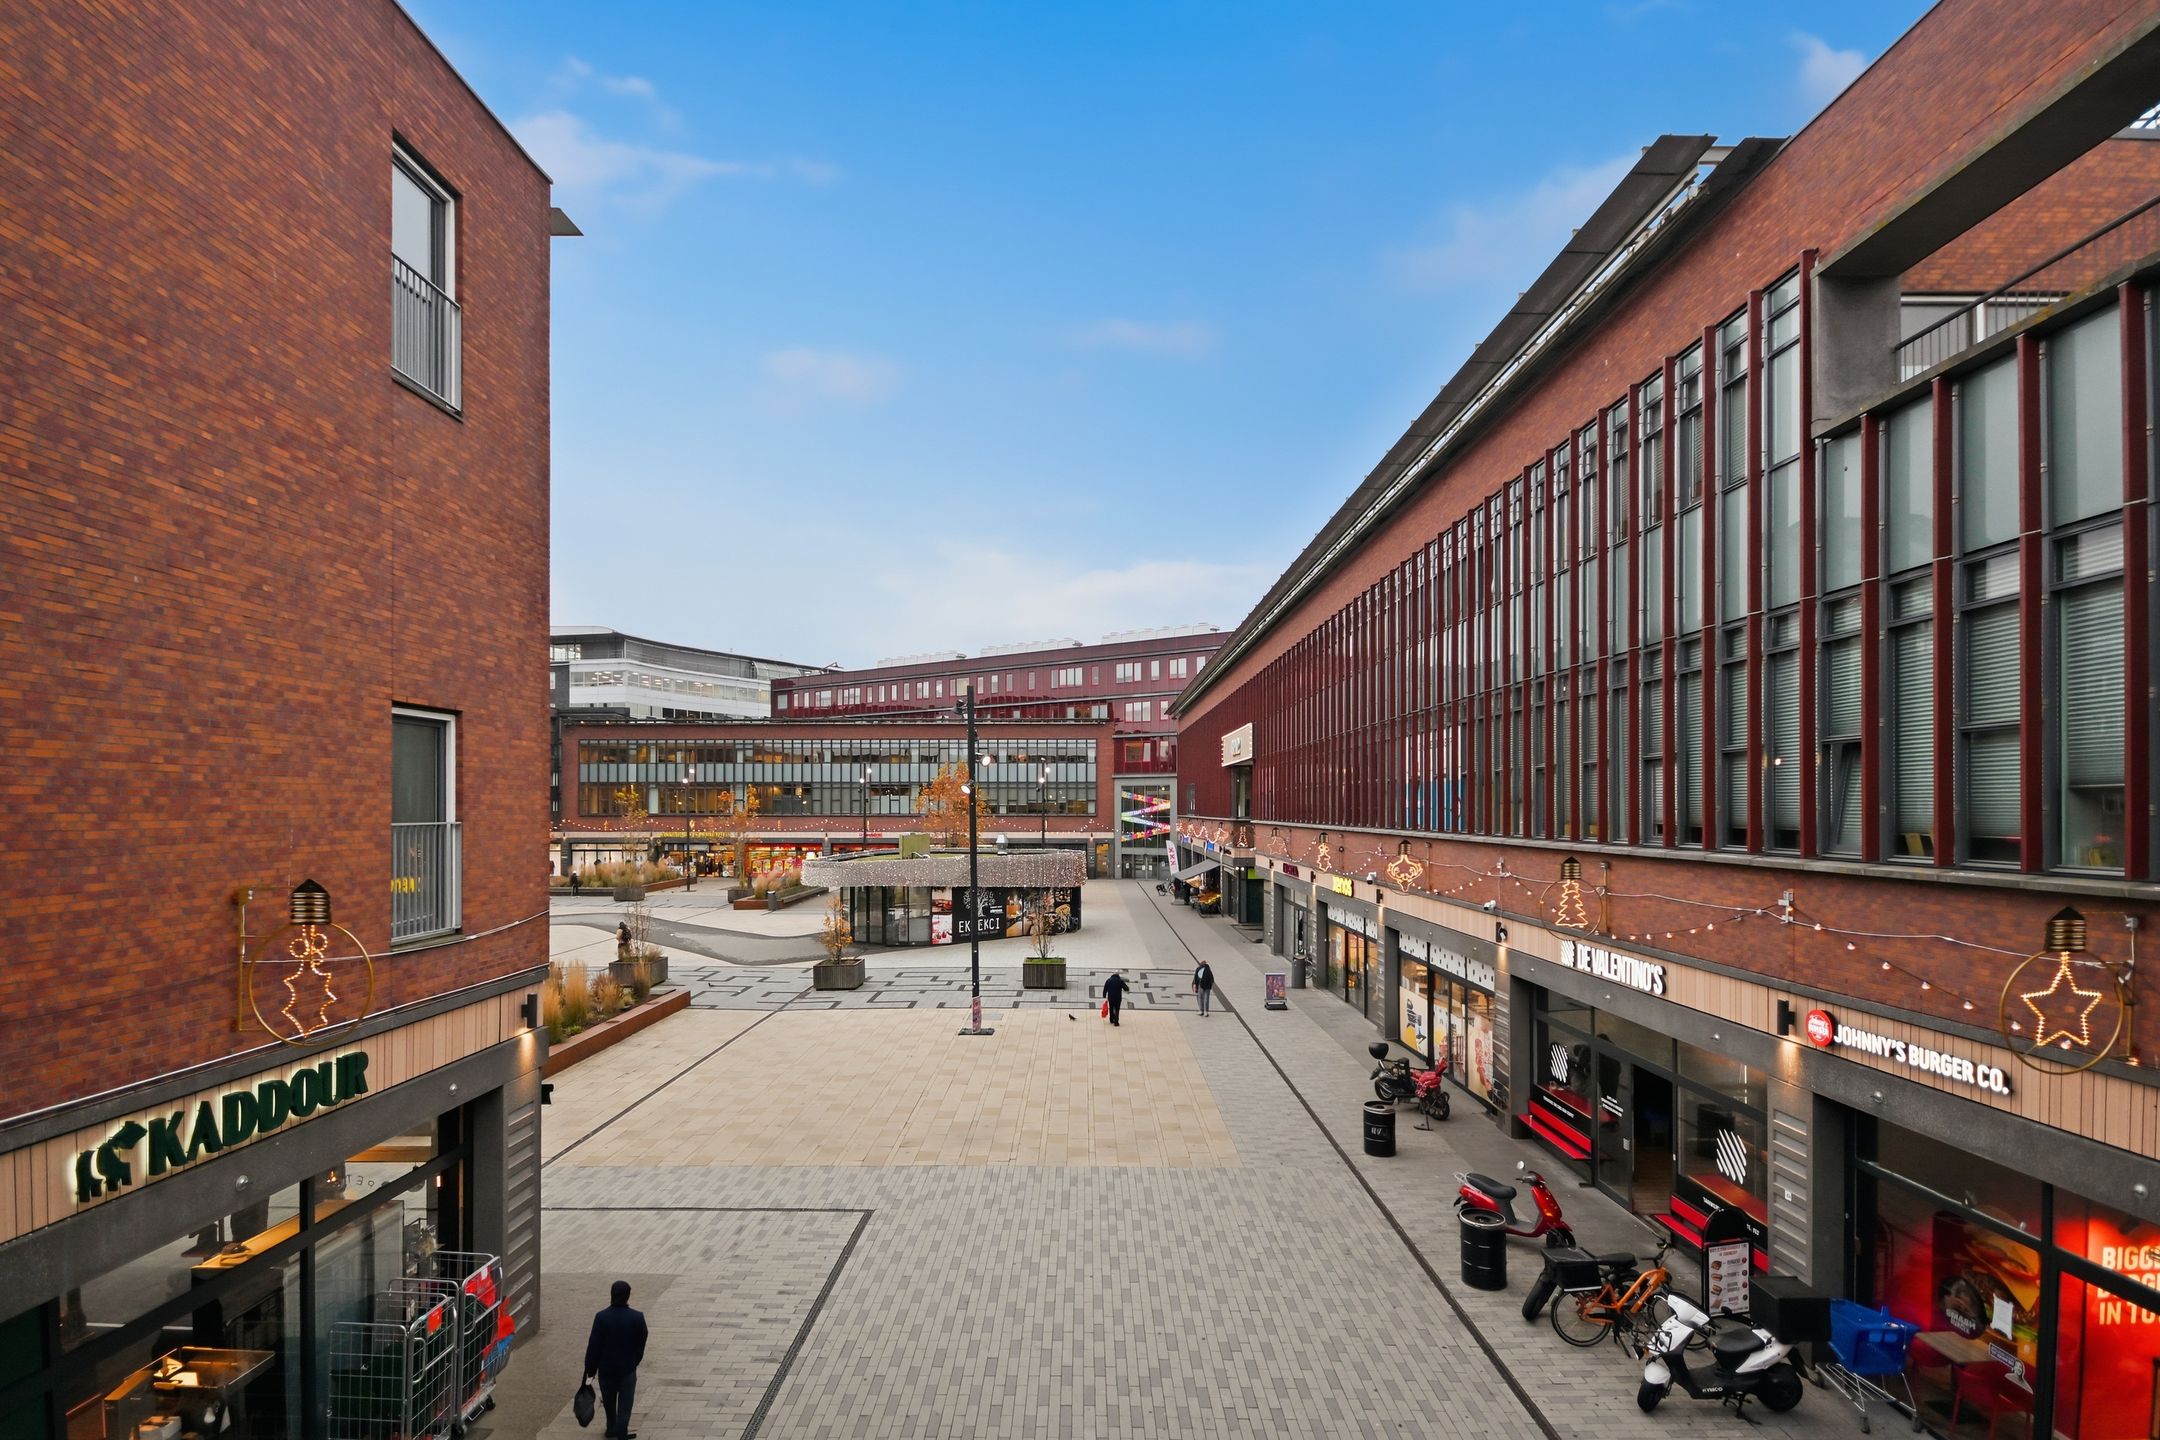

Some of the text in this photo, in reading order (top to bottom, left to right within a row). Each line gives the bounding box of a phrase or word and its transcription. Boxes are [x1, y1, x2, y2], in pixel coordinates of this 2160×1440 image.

[958, 917, 1000, 933] EKEKCI
[1577, 943, 1664, 996] DE VALENTINO'S
[1834, 1023, 2010, 1095] JOHNNY'S BURGER CO.
[148, 1051, 369, 1176] KADDOUR
[2099, 1301, 2122, 1325] IN
